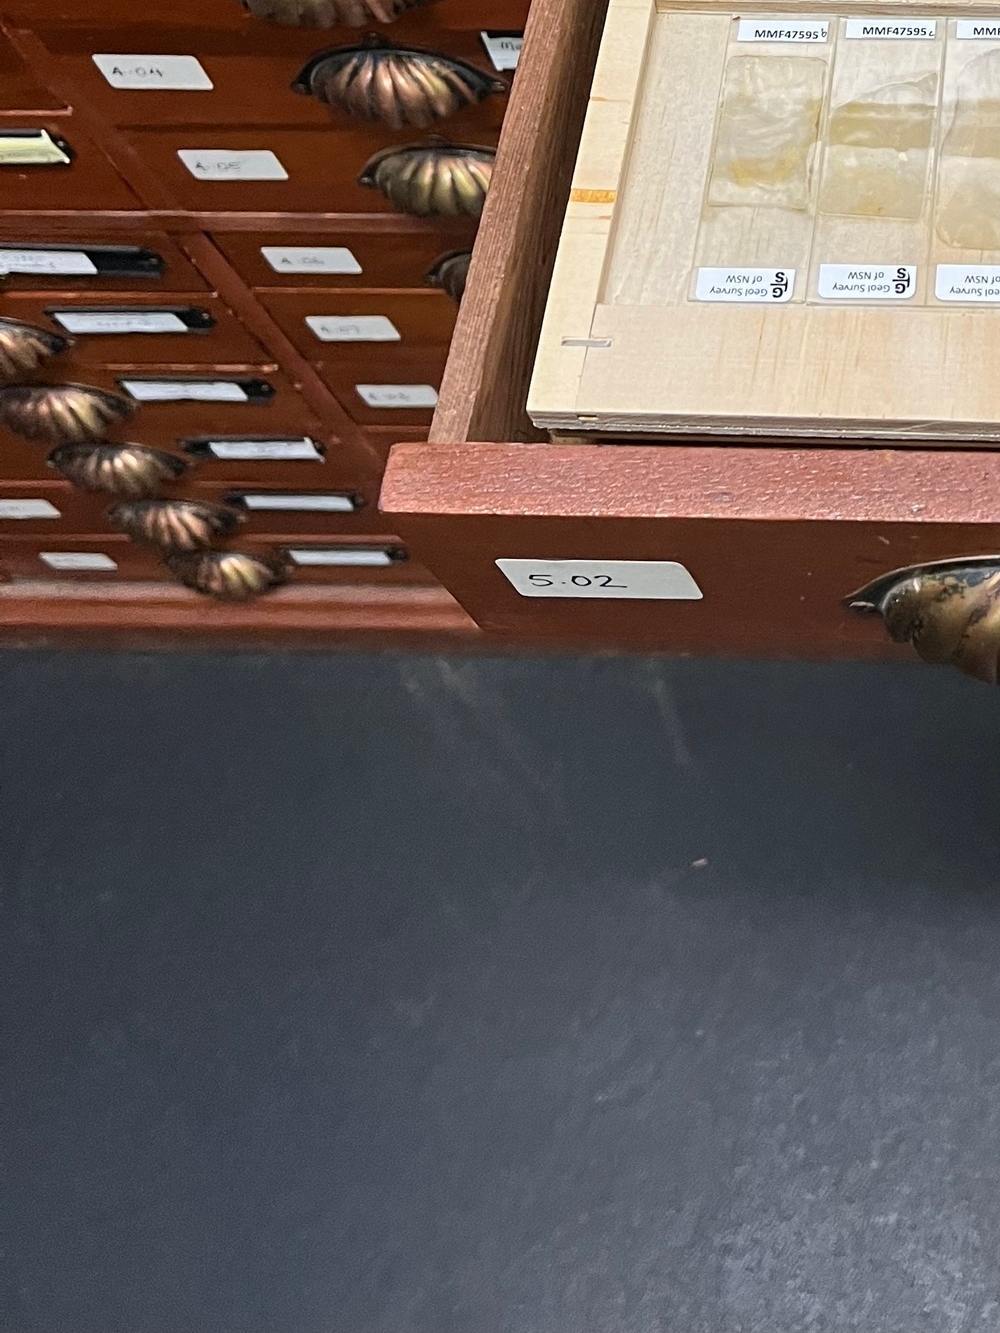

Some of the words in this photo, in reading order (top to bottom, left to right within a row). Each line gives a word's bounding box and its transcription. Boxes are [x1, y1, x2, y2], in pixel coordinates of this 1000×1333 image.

[725, 275, 750, 284] NSW
[751, 275, 763, 285] of
[847, 271, 872, 280] NSW
[873, 271, 885, 281] of
[964, 275, 989, 284] NSW
[709, 286, 743, 297] Survey
[832, 282, 866, 293] Survey
[868, 284, 891, 293] Geol
[949, 286, 983, 297] Survey
[745, 288, 768, 297] Geol
